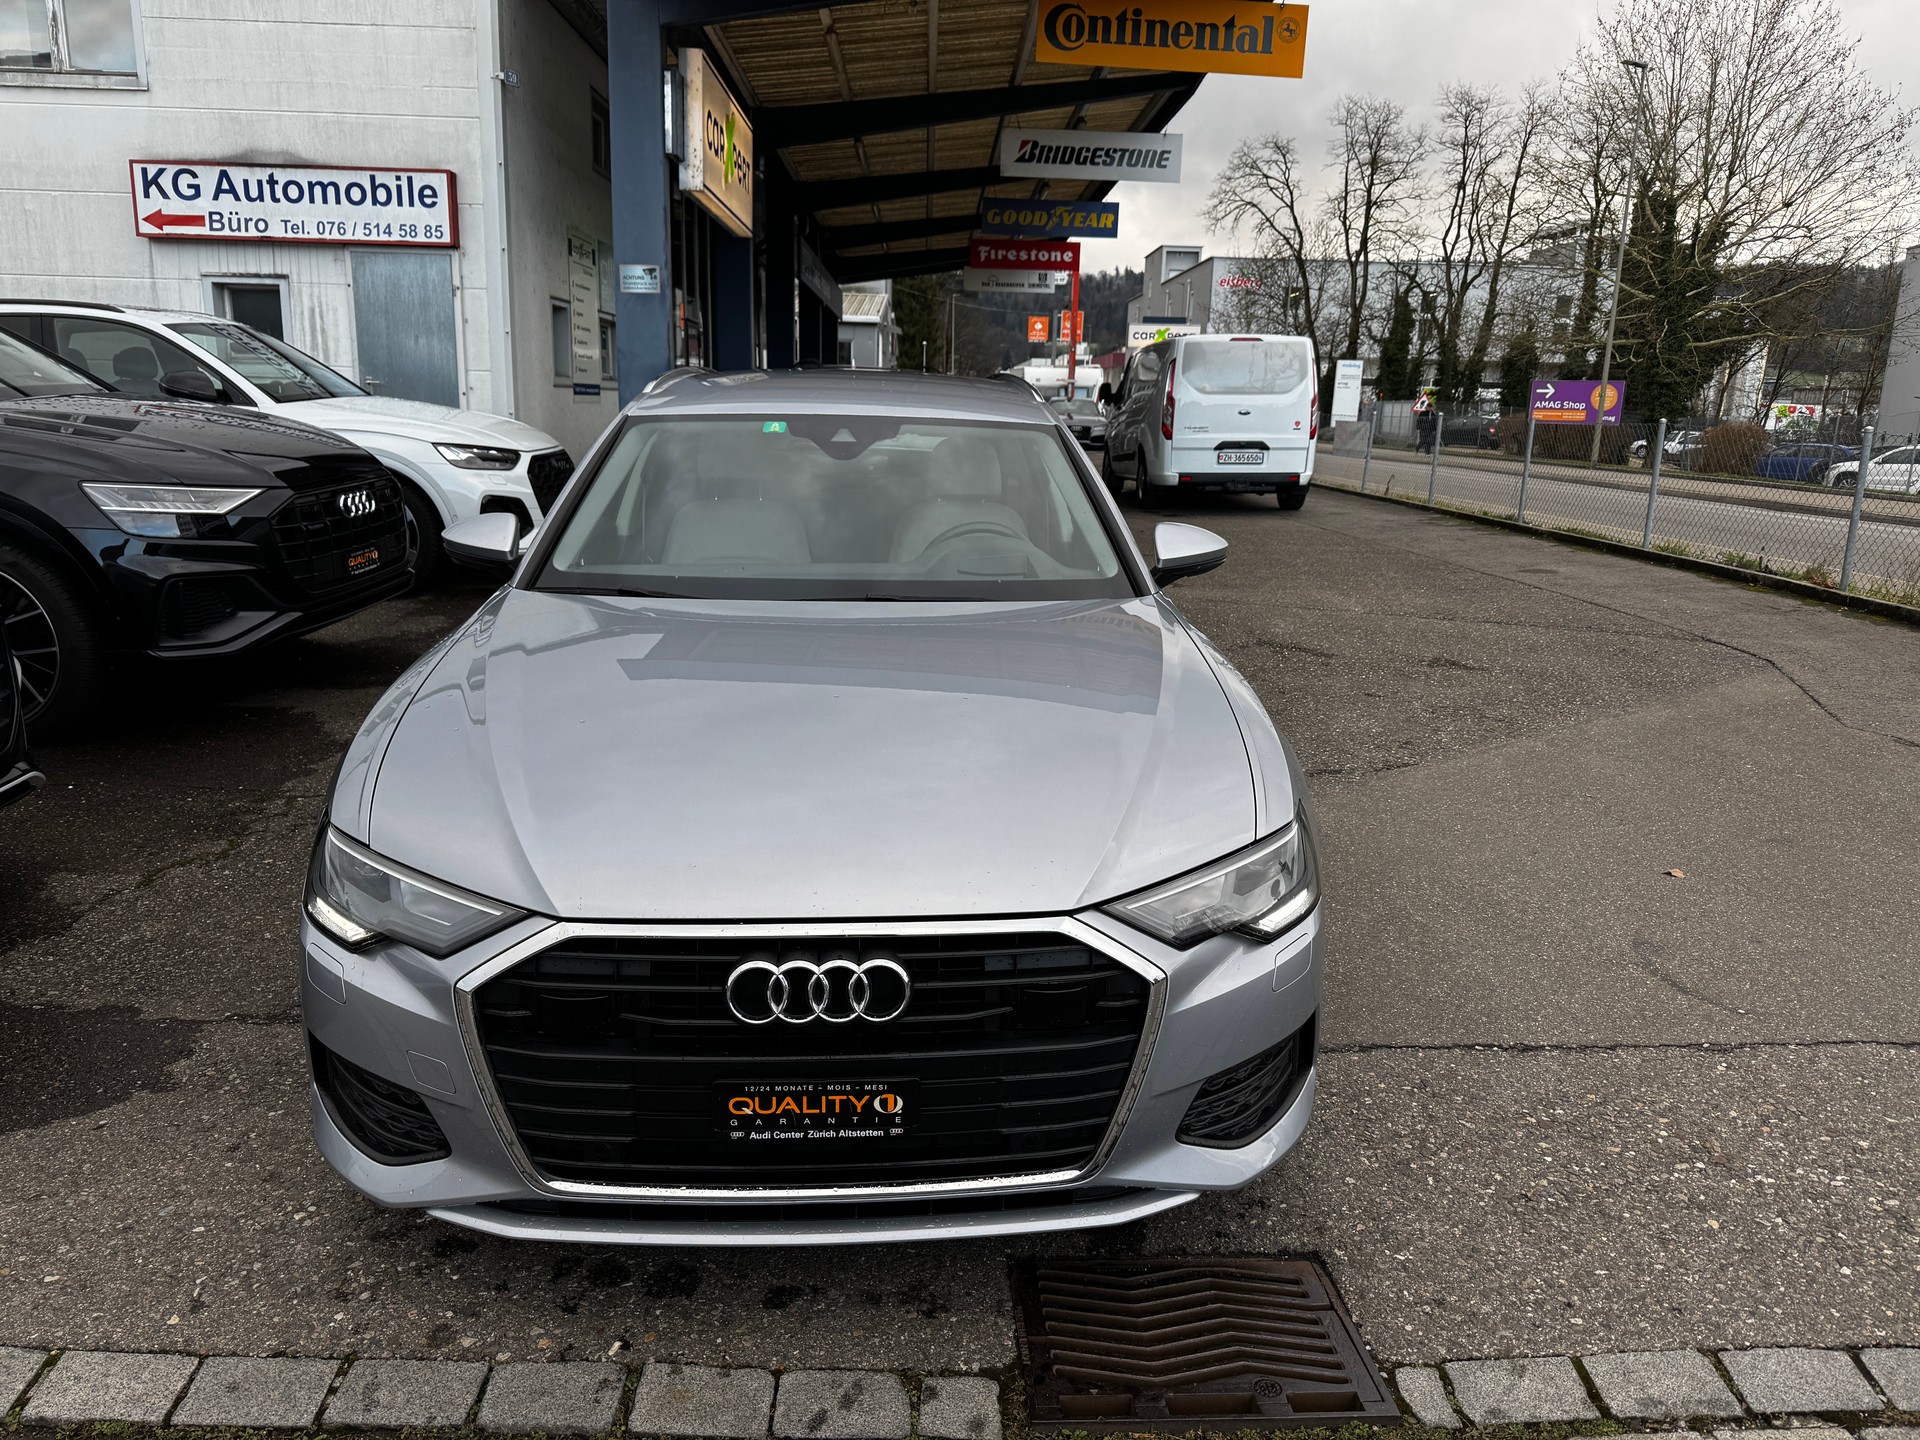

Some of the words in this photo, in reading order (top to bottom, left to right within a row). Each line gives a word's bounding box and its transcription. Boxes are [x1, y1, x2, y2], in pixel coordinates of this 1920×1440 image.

[1044, 3, 1275, 55] Continental
[1014, 139, 1172, 169] BRIDGESTONE
[140, 166, 202, 201] KG
[211, 169, 439, 209] Automobile
[208, 211, 269, 234] Büro
[280, 219, 311, 235] Tel.
[316, 220, 347, 236] 076
[352, 221, 358, 237] /
[362, 222, 393, 238] 514
[398, 223, 418, 239] 58
[423, 224, 444, 240] 85
[978, 246, 1074, 263] Firestone
[1219, 274, 1263, 289] eisberg
[1534, 401, 1561, 409] AMAG
[1563, 401, 1586, 410] Shop
[728, 1094, 870, 1115] QUALITY
[749, 1131, 771, 1139] Audi
[773, 1131, 804, 1139] Center
[807, 1129, 836, 1138] Zürich
[838, 1129, 884, 1138] Altstetten
